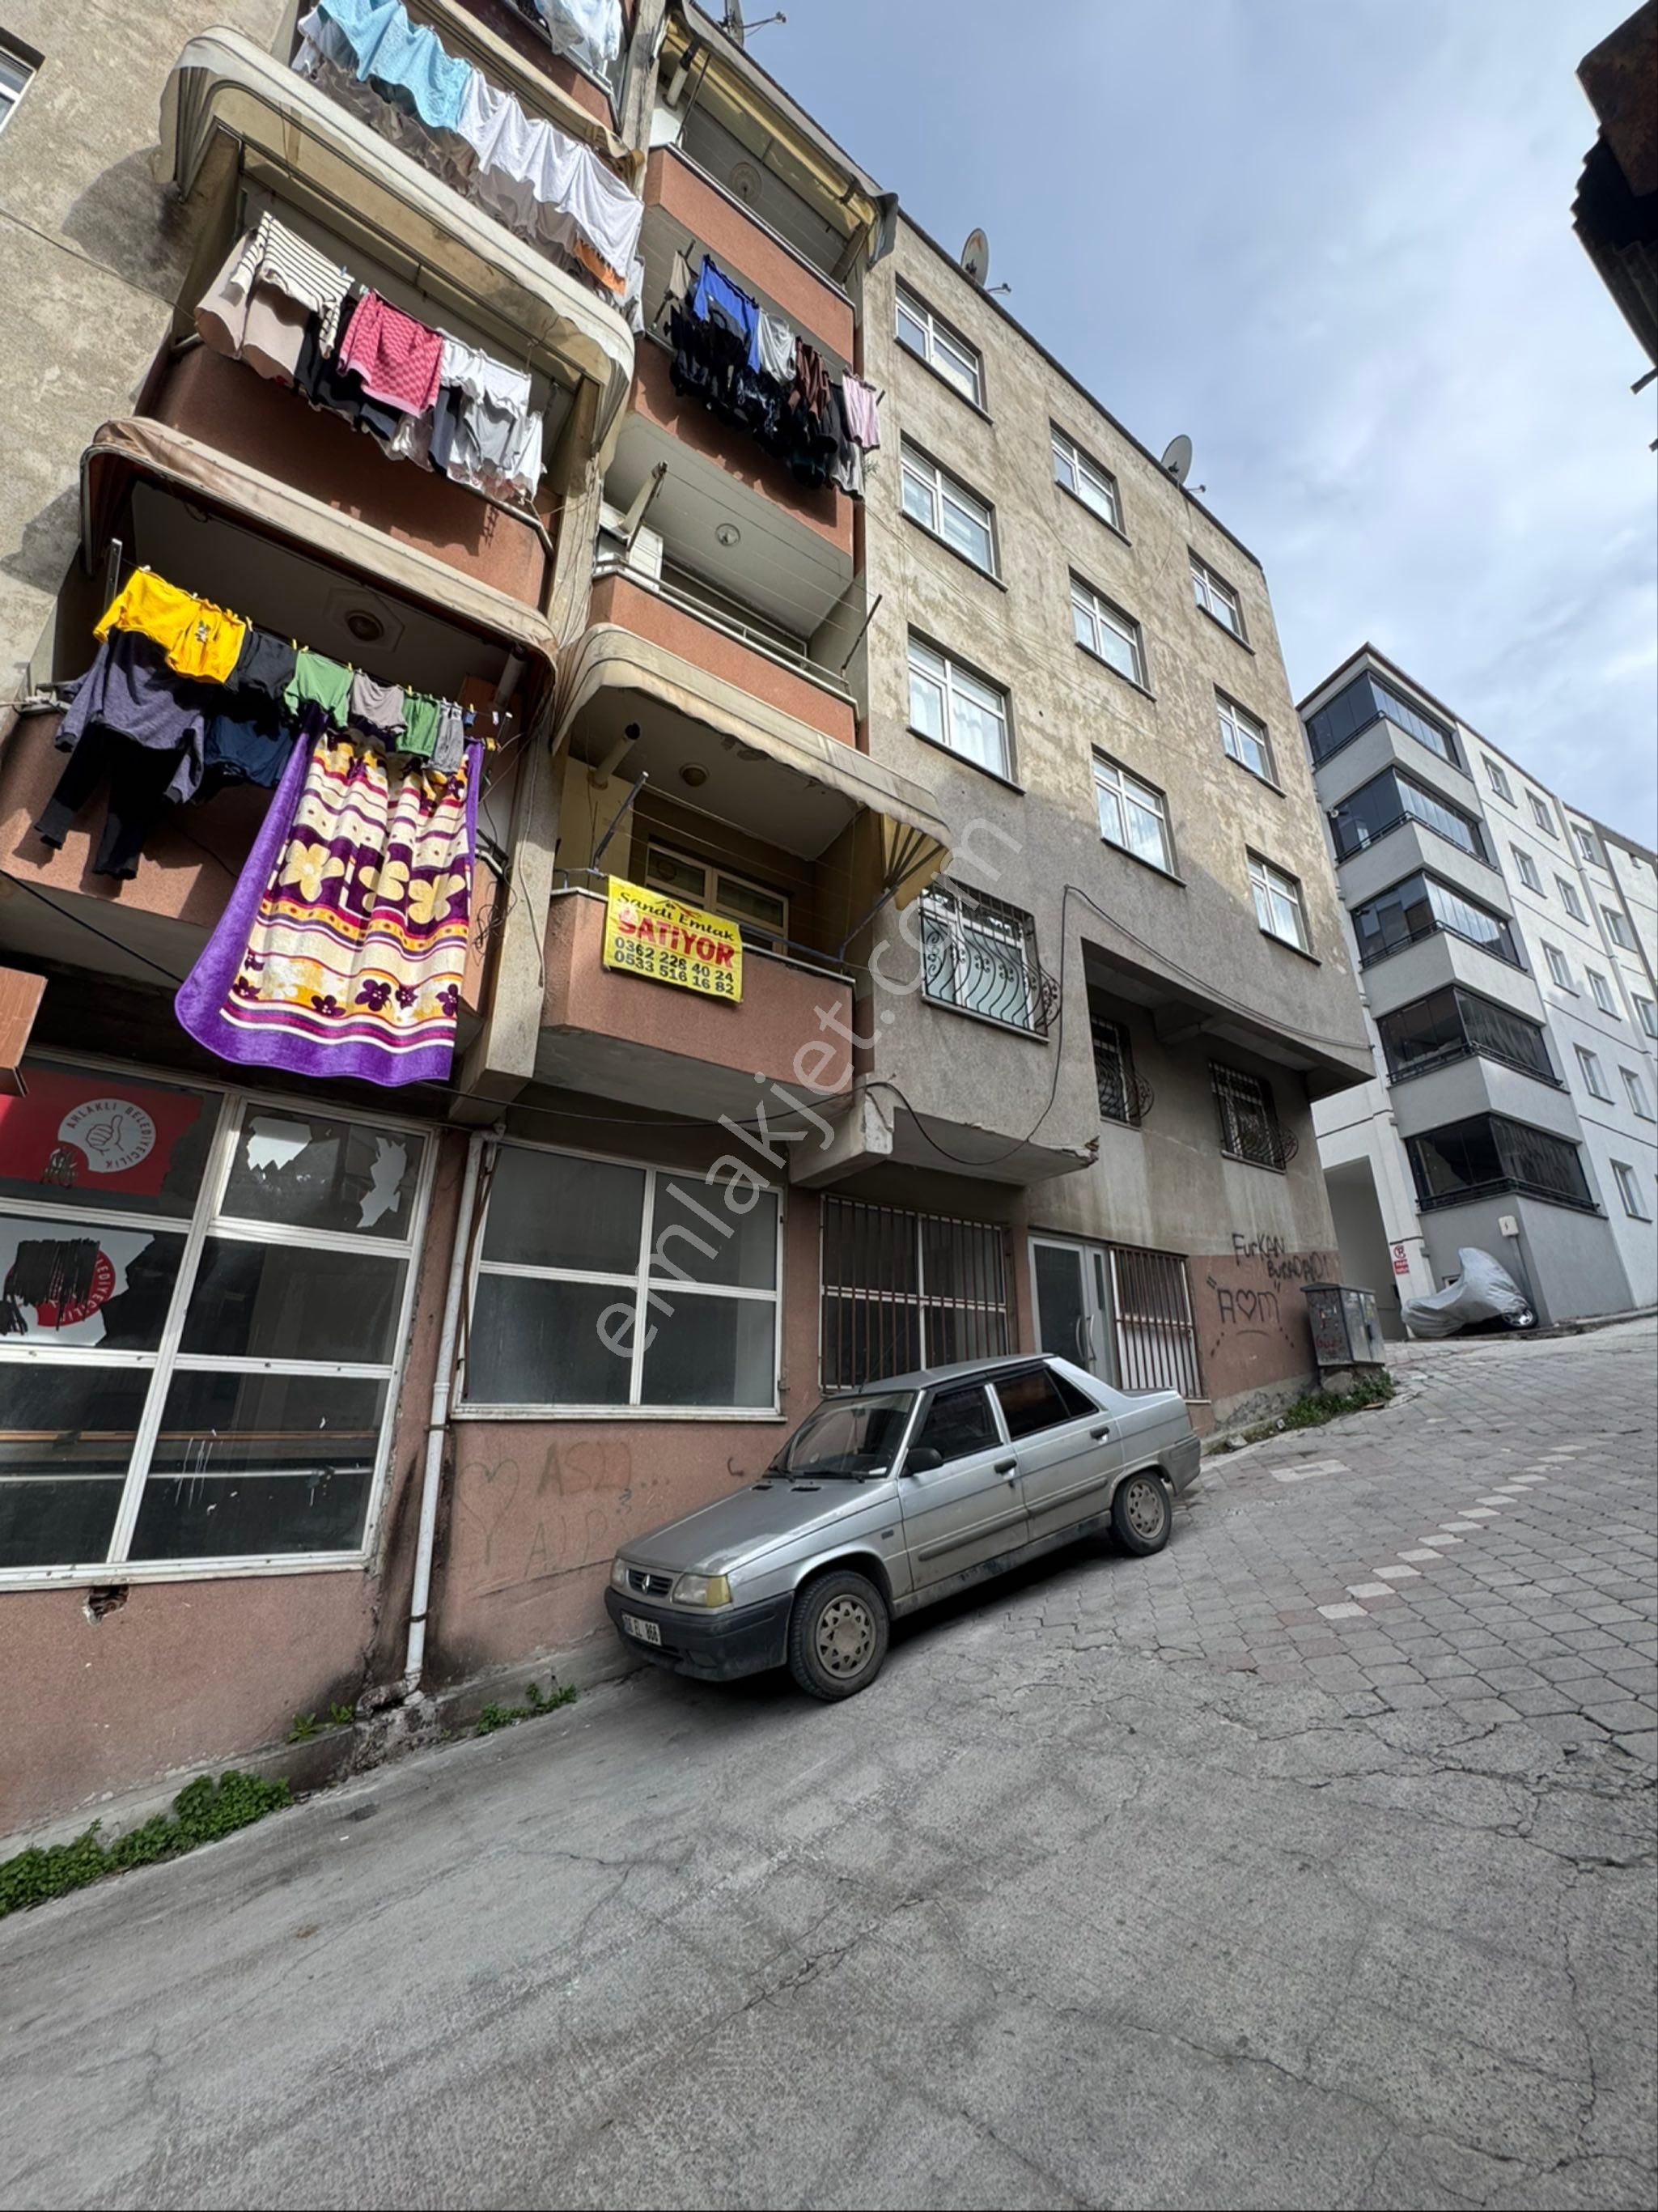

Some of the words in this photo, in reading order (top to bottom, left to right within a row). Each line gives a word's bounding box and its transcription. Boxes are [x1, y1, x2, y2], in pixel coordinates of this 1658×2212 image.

[614, 950, 655, 973] 0533
[659, 965, 687, 982] 516
[693, 975, 710, 990] 16
[715, 981, 735, 996] 82
[615, 936, 655, 961] 0362
[659, 951, 687, 970] 228
[692, 963, 710, 978] 40
[715, 970, 734, 983] 24
[66, 1102, 117, 1129] AHLAKLI
